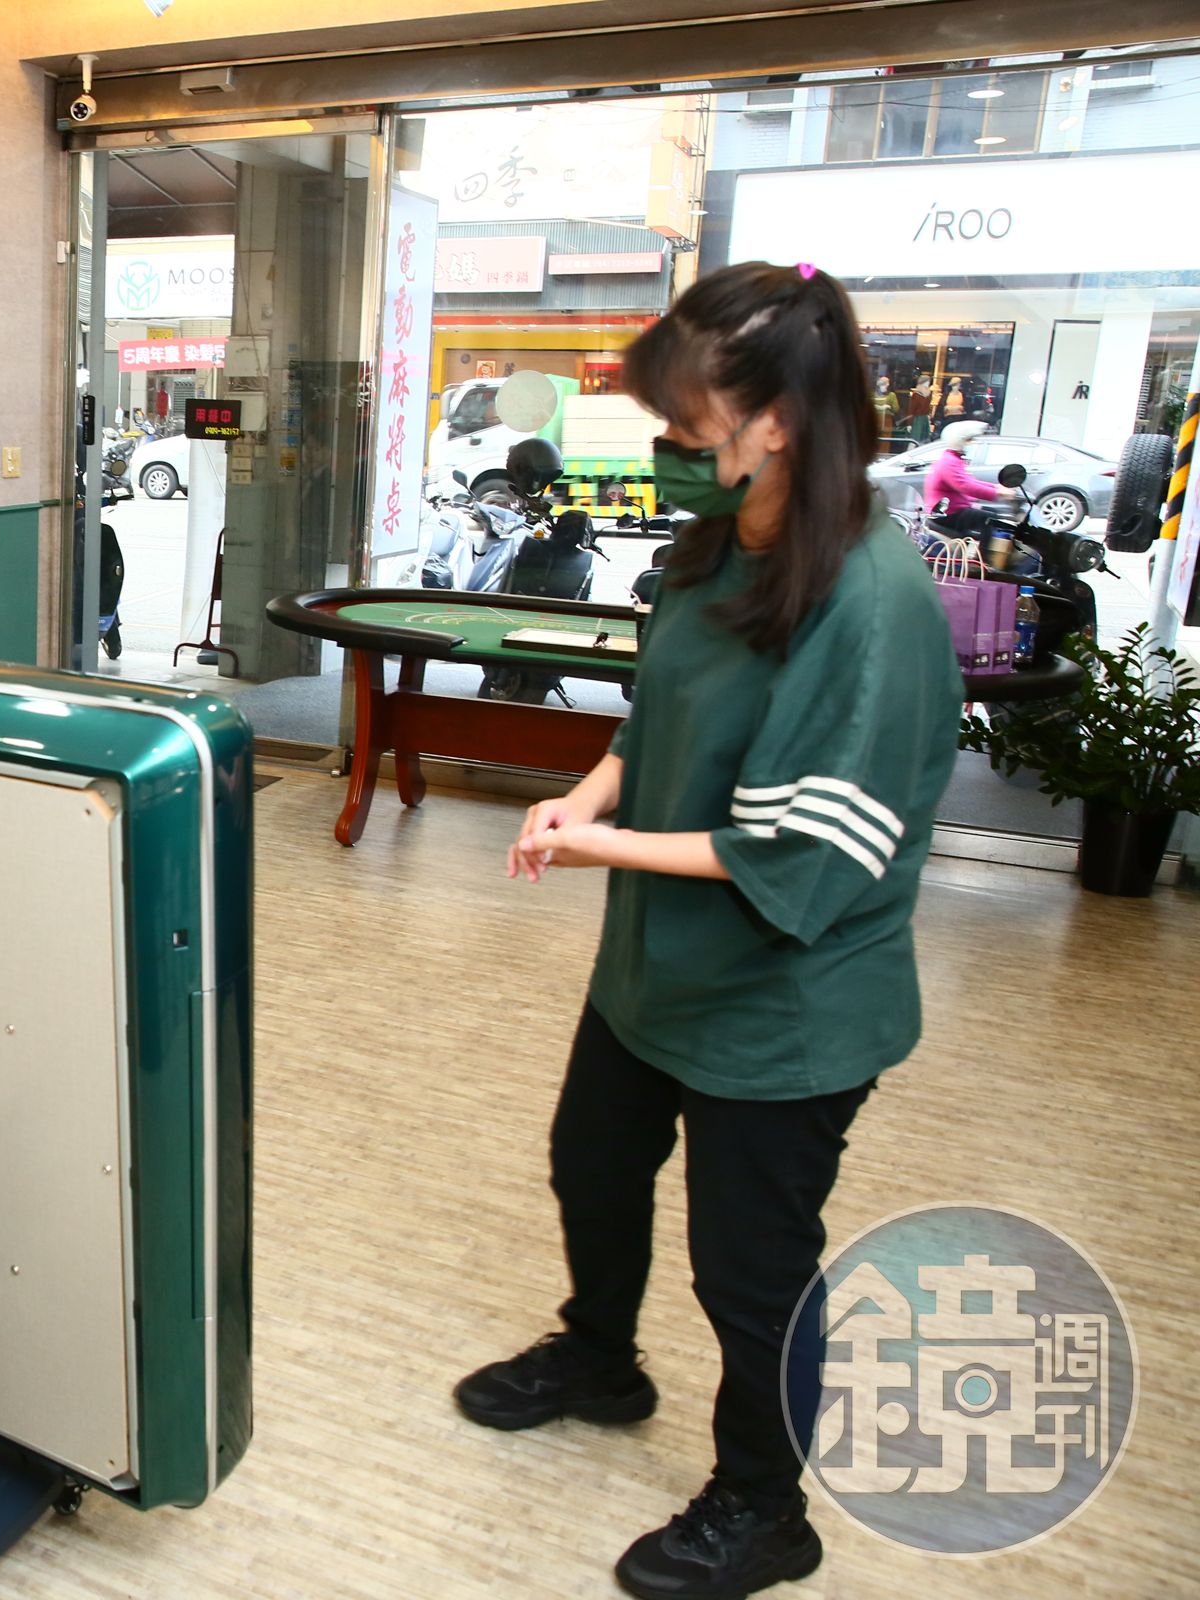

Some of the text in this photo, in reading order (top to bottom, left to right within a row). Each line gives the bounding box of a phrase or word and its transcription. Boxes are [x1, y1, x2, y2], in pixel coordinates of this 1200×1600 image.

[454, 145, 538, 208] 四季
[912, 202, 1012, 242] iROO
[382, 222, 417, 537] 電動麻將桌
